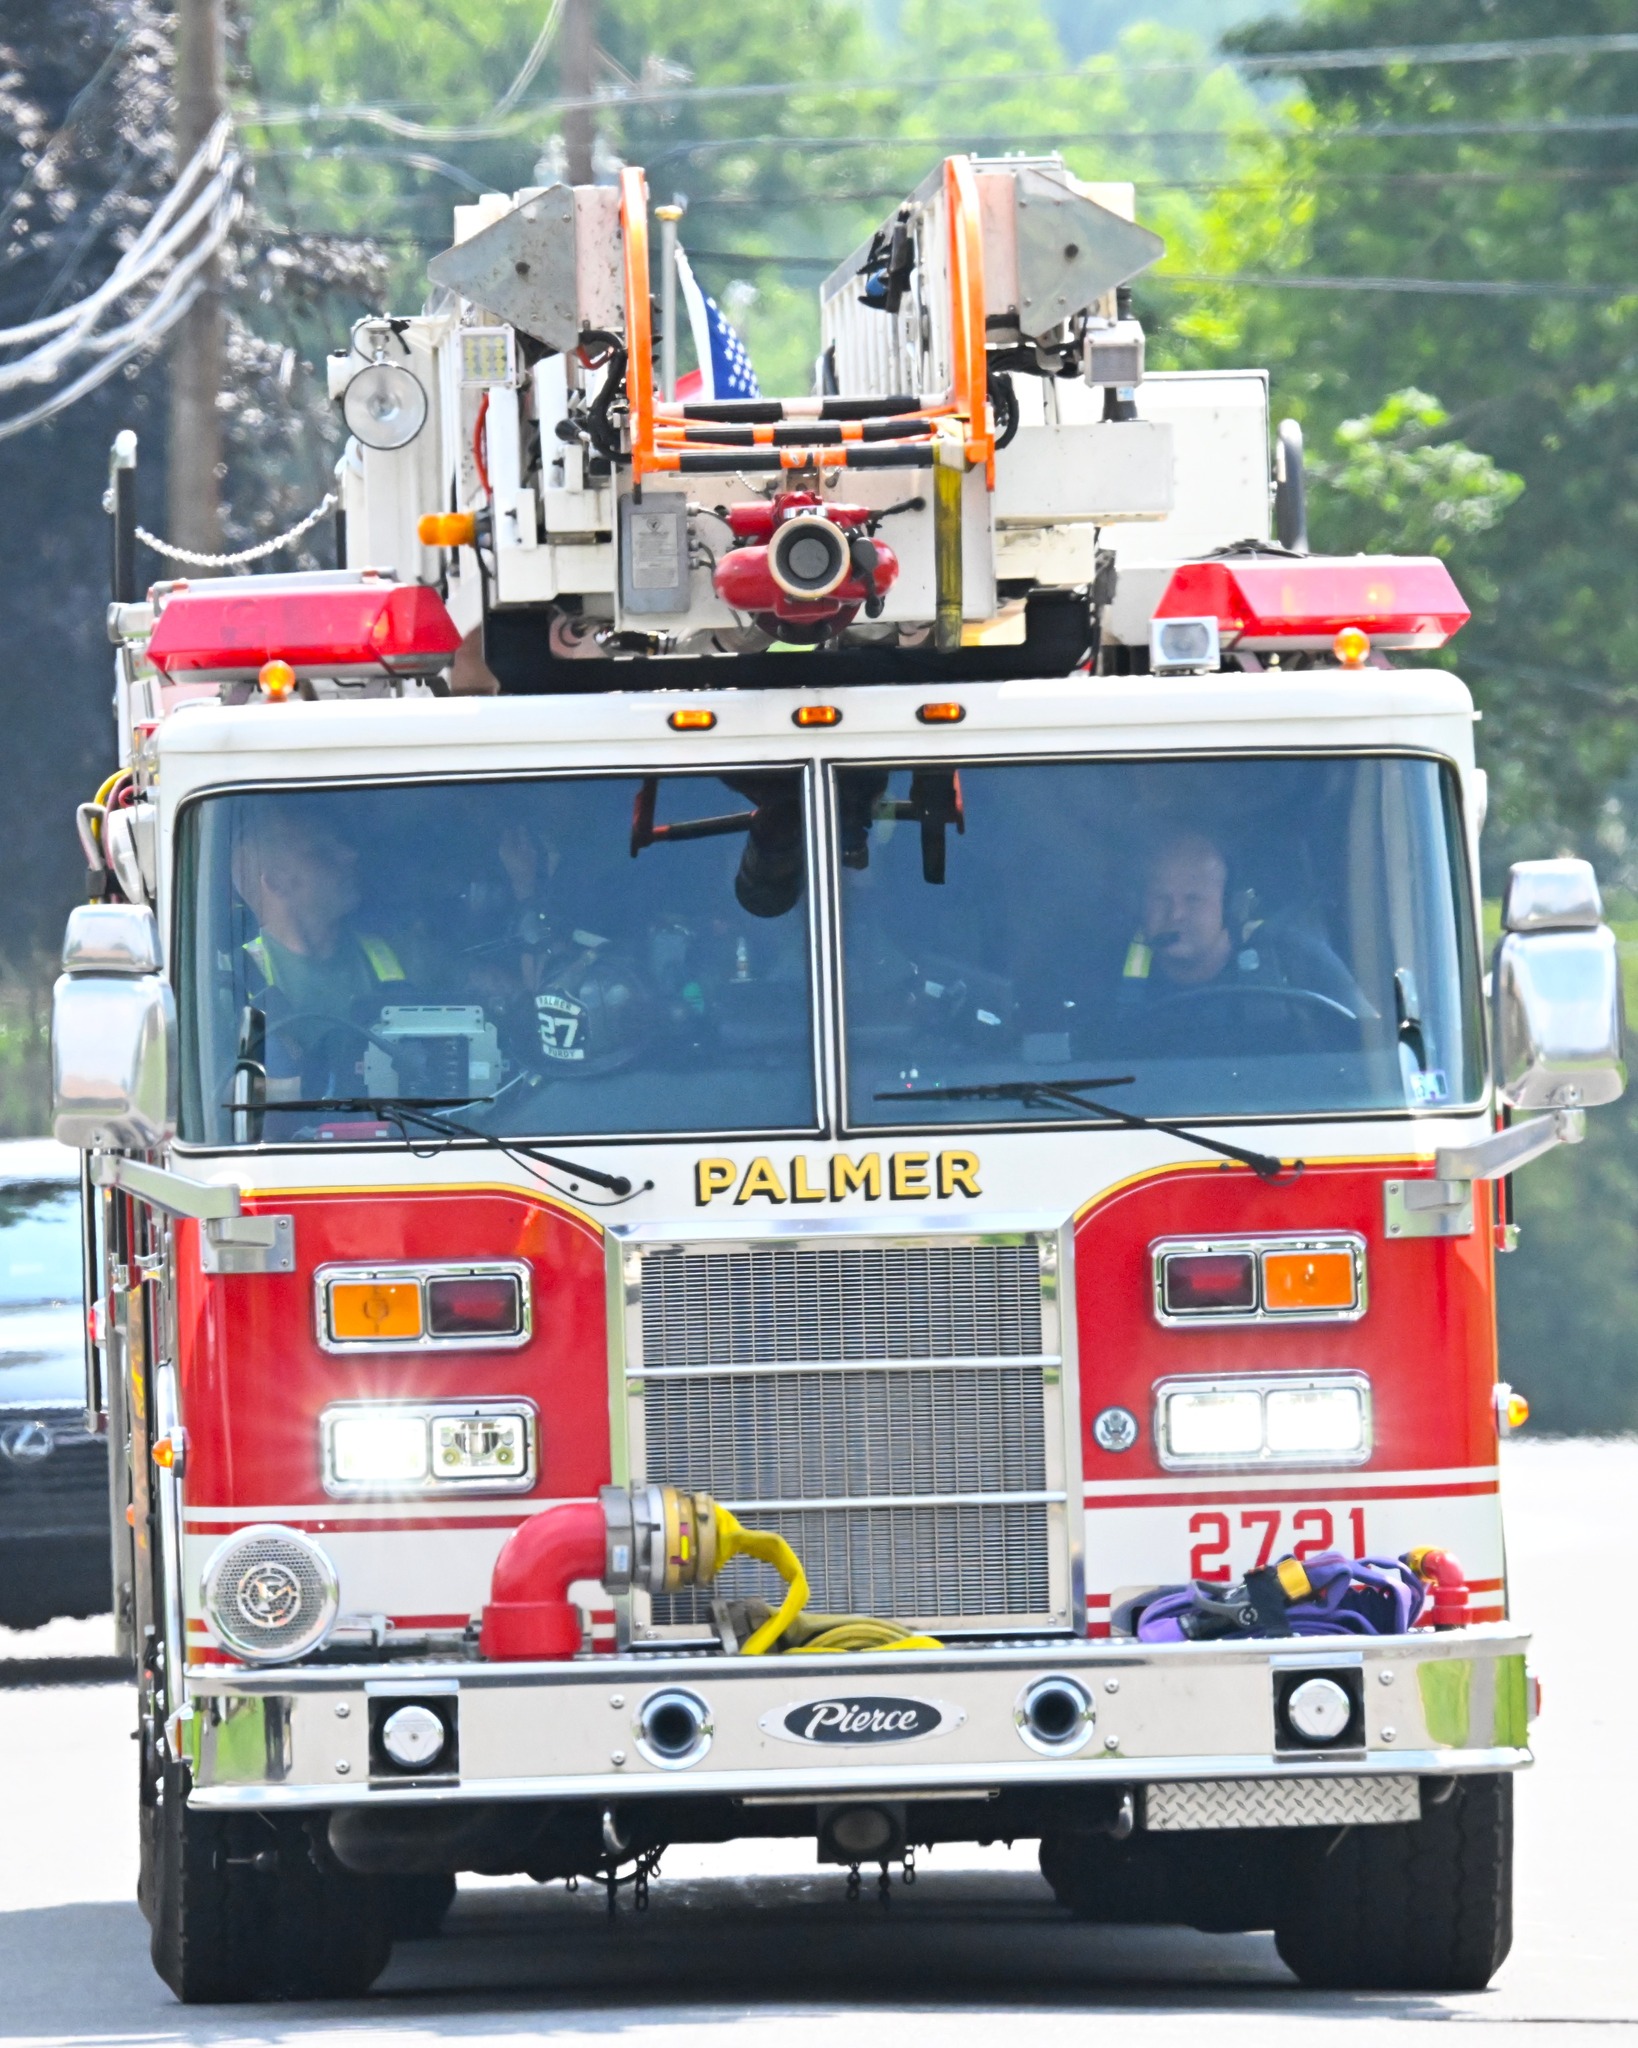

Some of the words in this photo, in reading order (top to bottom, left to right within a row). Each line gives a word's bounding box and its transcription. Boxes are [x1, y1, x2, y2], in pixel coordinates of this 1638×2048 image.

[538, 996, 573, 1012] PALMER
[537, 1012, 579, 1048] 27
[694, 1150, 983, 1206] PALMER
[1189, 1507, 1366, 1582] 2721
[804, 1702, 919, 1739] Pierce
